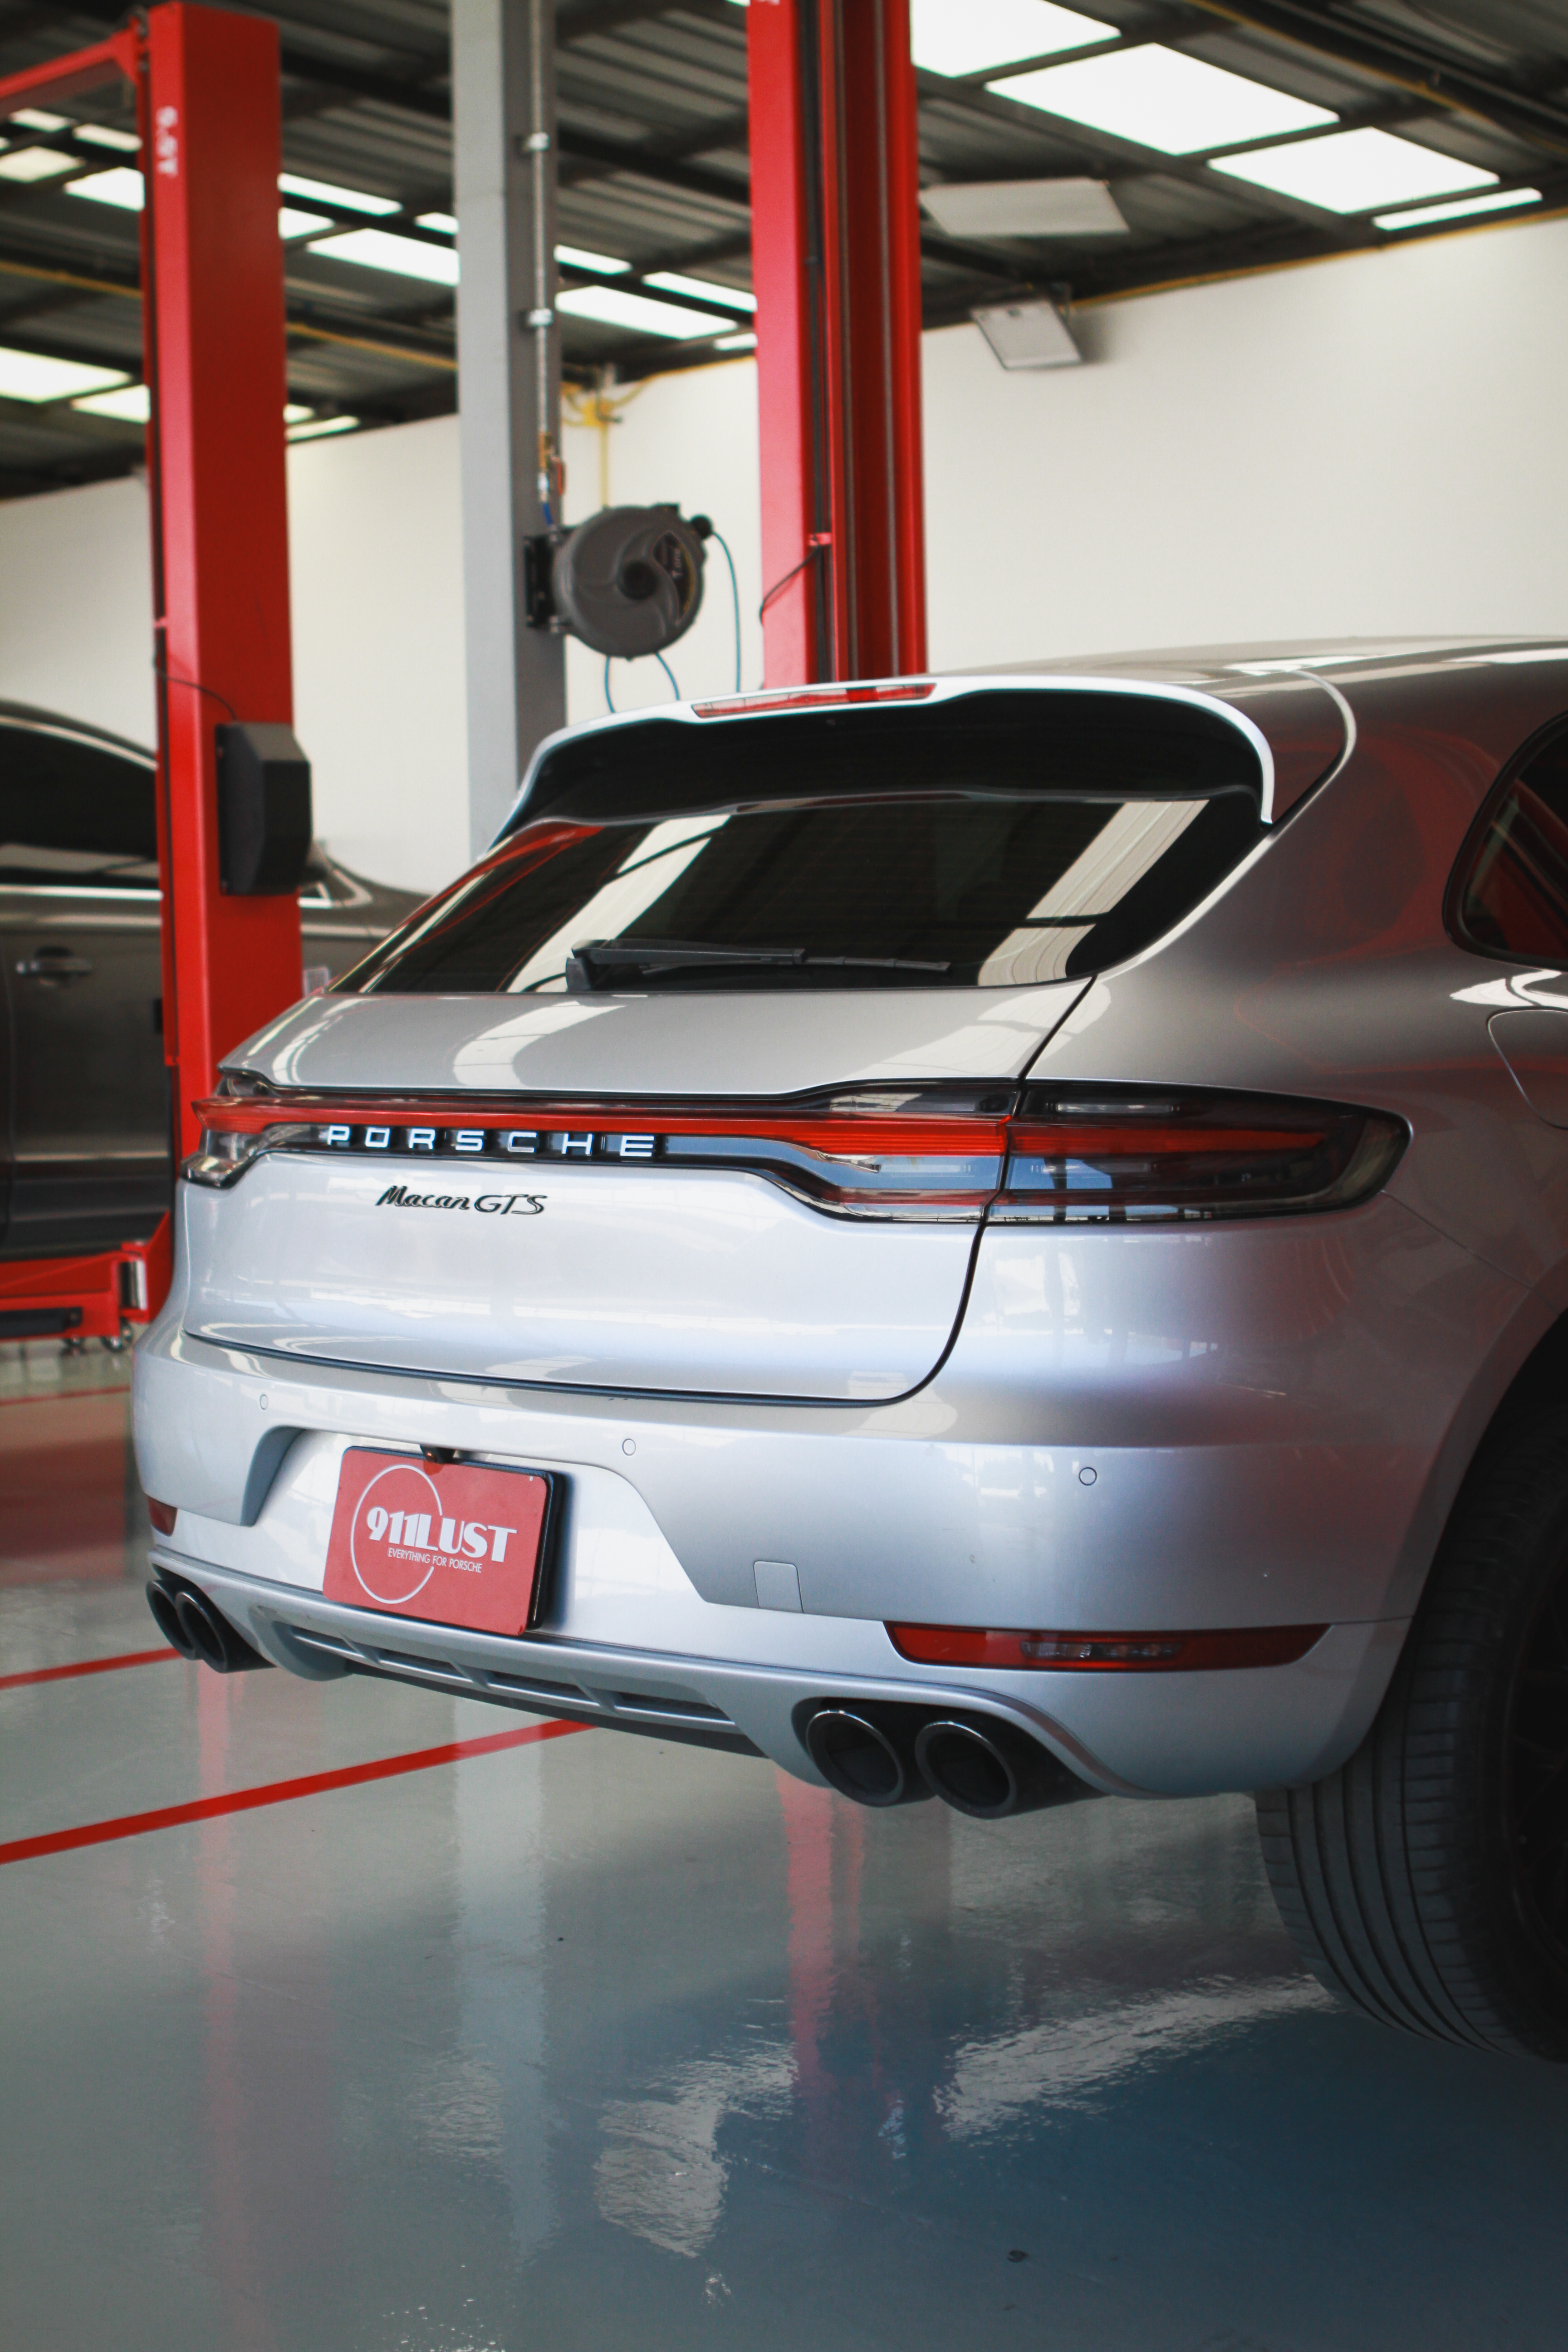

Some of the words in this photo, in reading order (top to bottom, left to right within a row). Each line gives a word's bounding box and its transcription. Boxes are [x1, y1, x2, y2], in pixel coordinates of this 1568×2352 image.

[326, 1125, 655, 1157] PORSCHE
[375, 1185, 470, 1210] Macan
[474, 1194, 548, 1215] GTS
[367, 1506, 517, 1563] 911LUST
[388, 1548, 431, 1564] EVERYTHING
[432, 1555, 447, 1567] FOR
[449, 1558, 483, 1573] PORSCHE
